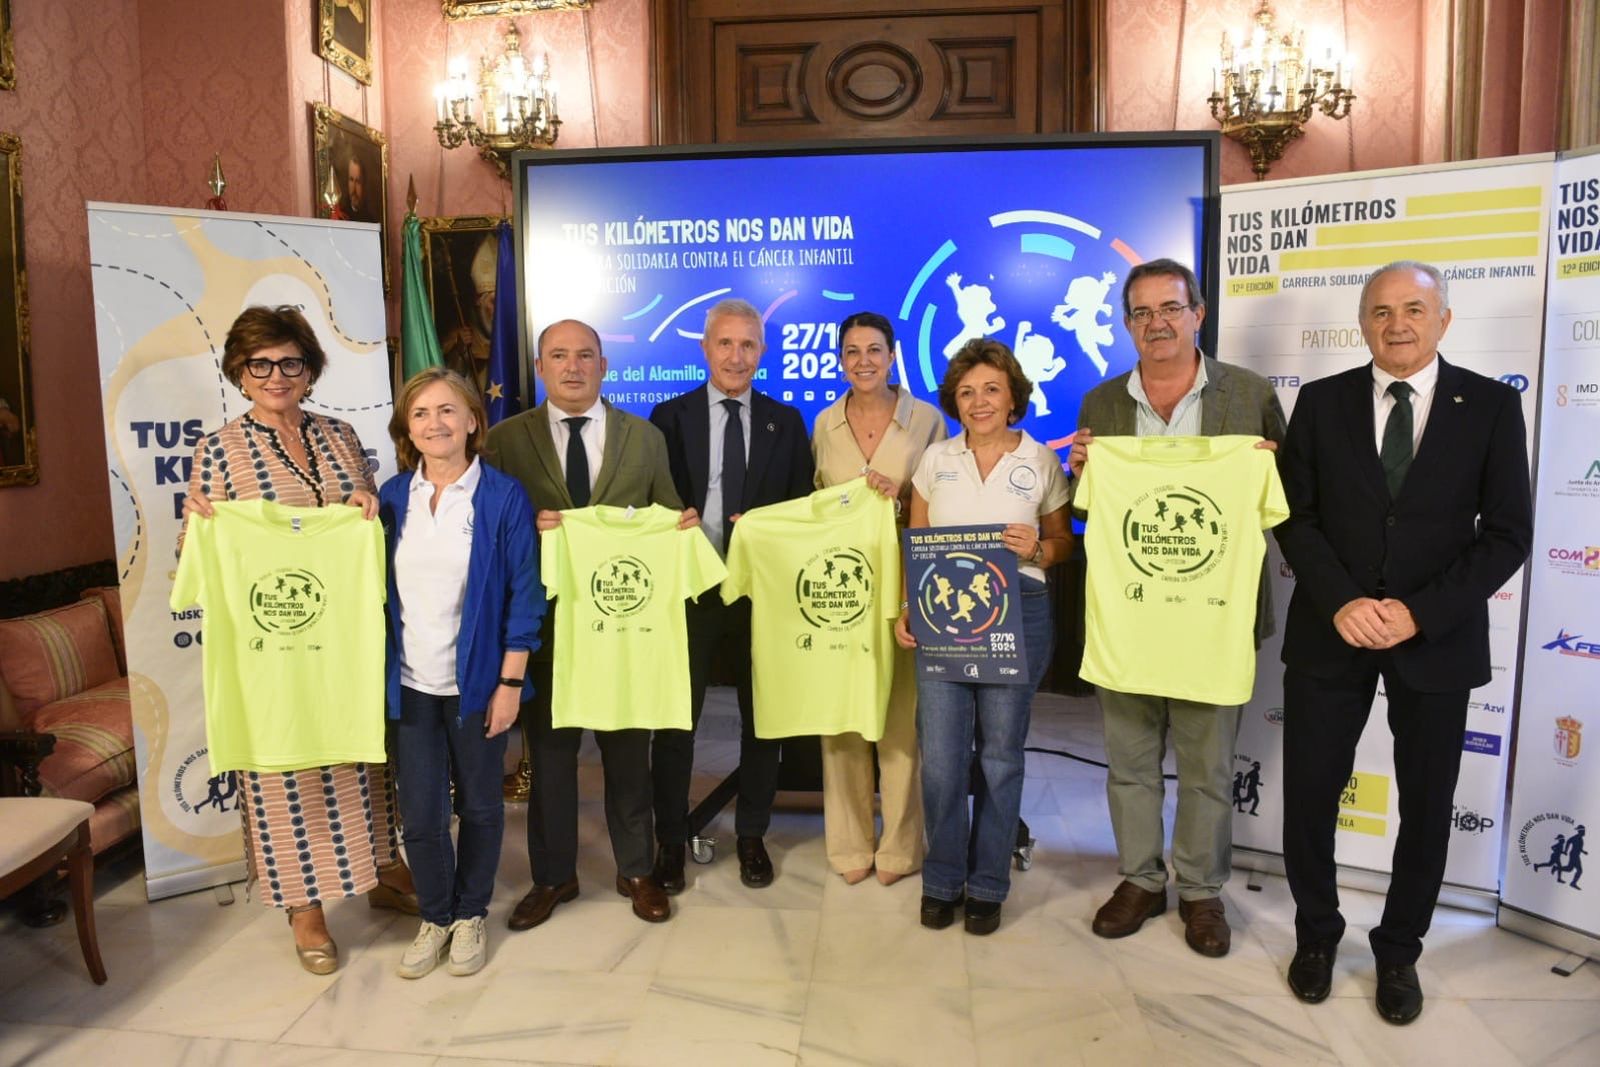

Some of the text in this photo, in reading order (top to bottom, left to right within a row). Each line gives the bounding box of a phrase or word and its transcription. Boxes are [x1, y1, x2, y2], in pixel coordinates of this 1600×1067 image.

[1559, 178, 1600, 205] TUS
[1228, 198, 1397, 233] TUS KILÓMETROS
[1558, 204, 1600, 230] NOS
[605, 215, 720, 246] KILÓMETROS
[726, 218, 763, 243] NOS
[769, 216, 806, 241] DAN
[811, 215, 854, 240] VIDA
[1227, 228, 1308, 254] NOS DAN
[617, 252, 678, 270] SOLIDARIA
[682, 250, 728, 269] CONTRA
[733, 250, 744, 267] EL
[748, 247, 795, 267] CÁNCER
[799, 248, 854, 266] INFANTIL
[1227, 254, 1270, 276] VIDA
[1246, 280, 1274, 292] EDICIÓN
[1282, 275, 1326, 289] CARRERA
[1444, 265, 1486, 281] CÁNCER
[1489, 264, 1536, 278] INFANTIL
[782, 322, 841, 350] 27/1
[1301, 328, 1368, 349] PATROCI
[623, 365, 645, 382] del
[649, 364, 706, 382] Alamillo
[782, 352, 844, 379] 202
[1576, 383, 1599, 393] IMD
[130, 418, 206, 449] TUS
[1141, 524, 1159, 533] TUS
[911, 535, 923, 544] TUS
[1141, 534, 1197, 545] KILÓMETROS
[1141, 547, 1202, 557] NOS DAN VIDA
[812, 581, 827, 589] TUS
[812, 601, 827, 609] NOS
[845, 600, 860, 608] VIDA
[990, 632, 1015, 642] 27/10
[991, 642, 1016, 652] 2024
[1483, 702, 1505, 714] Azvi
